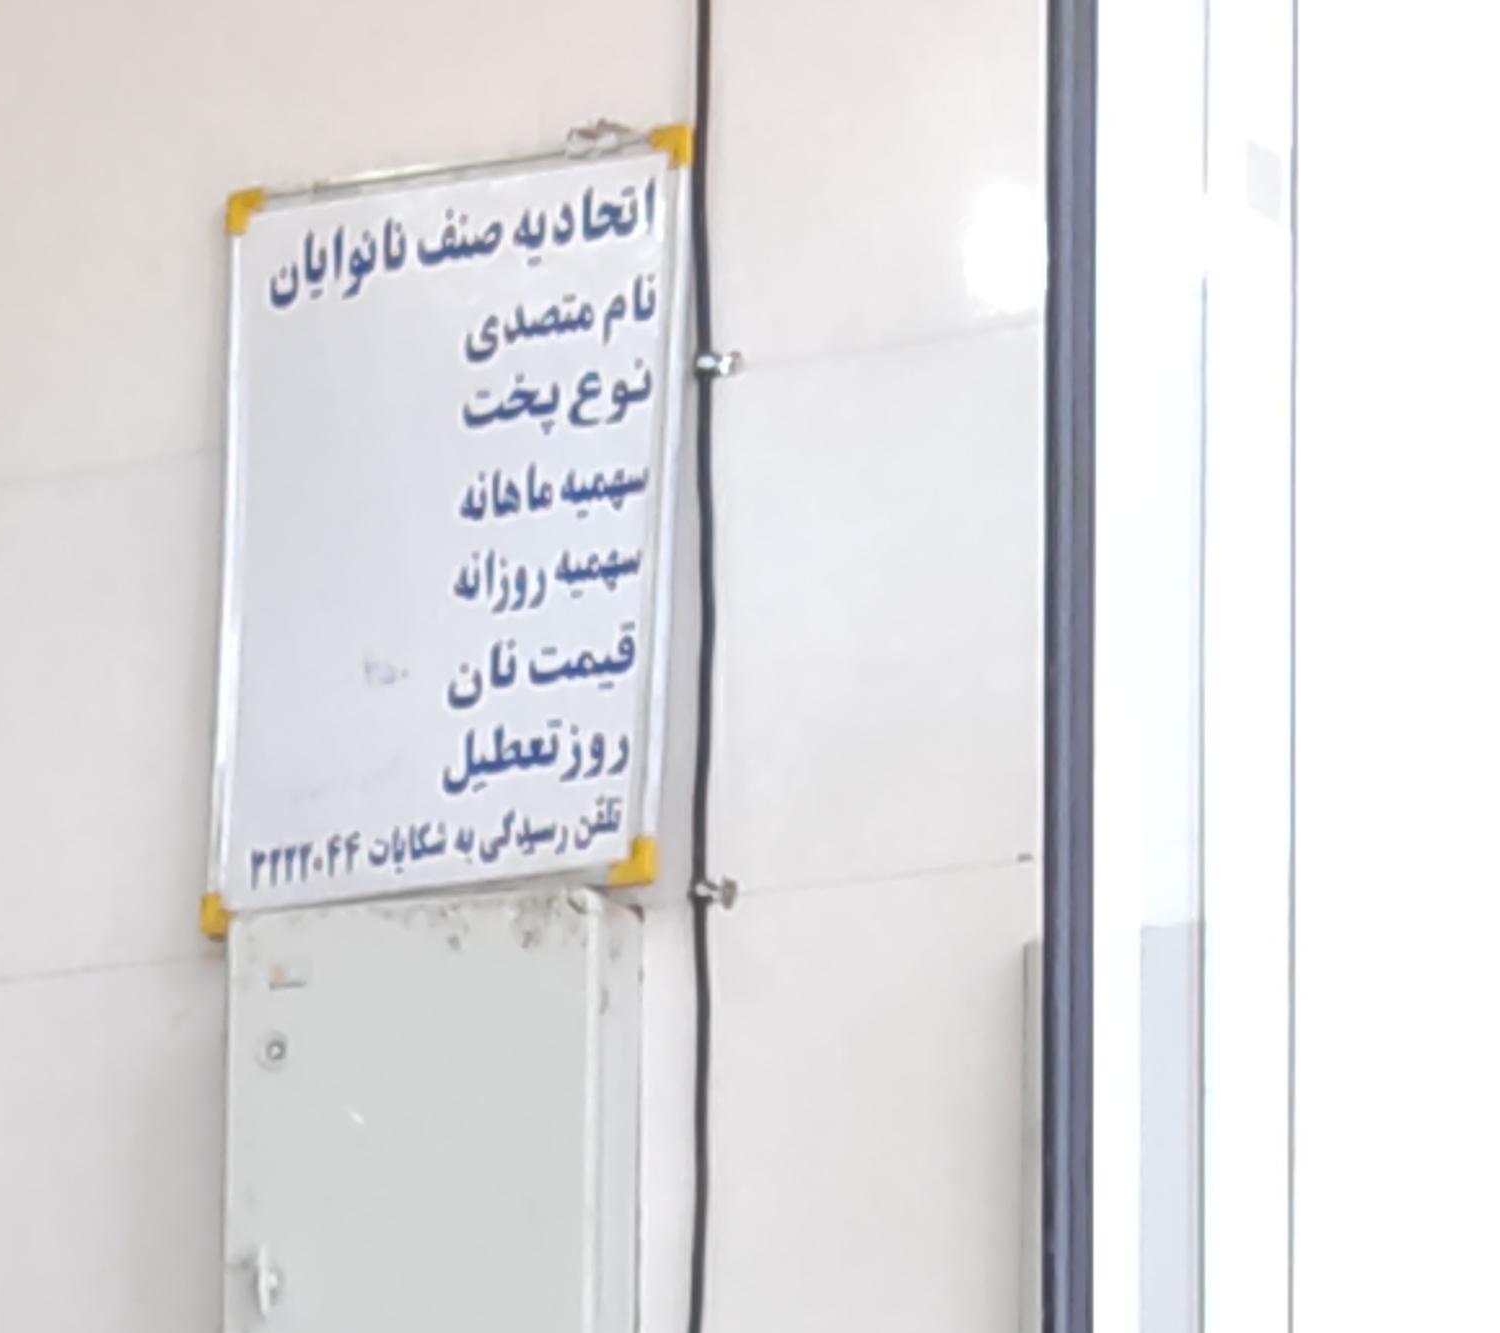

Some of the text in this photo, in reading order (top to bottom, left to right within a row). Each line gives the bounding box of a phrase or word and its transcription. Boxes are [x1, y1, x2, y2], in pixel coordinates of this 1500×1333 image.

[269, 177, 657, 307] اتحادیه صنف نانوایان
[464, 273, 657, 363] نام متصدی
[461, 358, 653, 436] نوع پخت
[460, 461, 650, 523] سهمیه ماهانه
[453, 547, 642, 613] سهمیه روزانه
[447, 621, 637, 710] قیمت نان
[442, 718, 562, 795] تعطیل
[367, 821, 447, 874] شکایات
[453, 827, 475, 865] به
[480, 808, 569, 864] رسیدگی
[573, 795, 622, 851] تلفن
